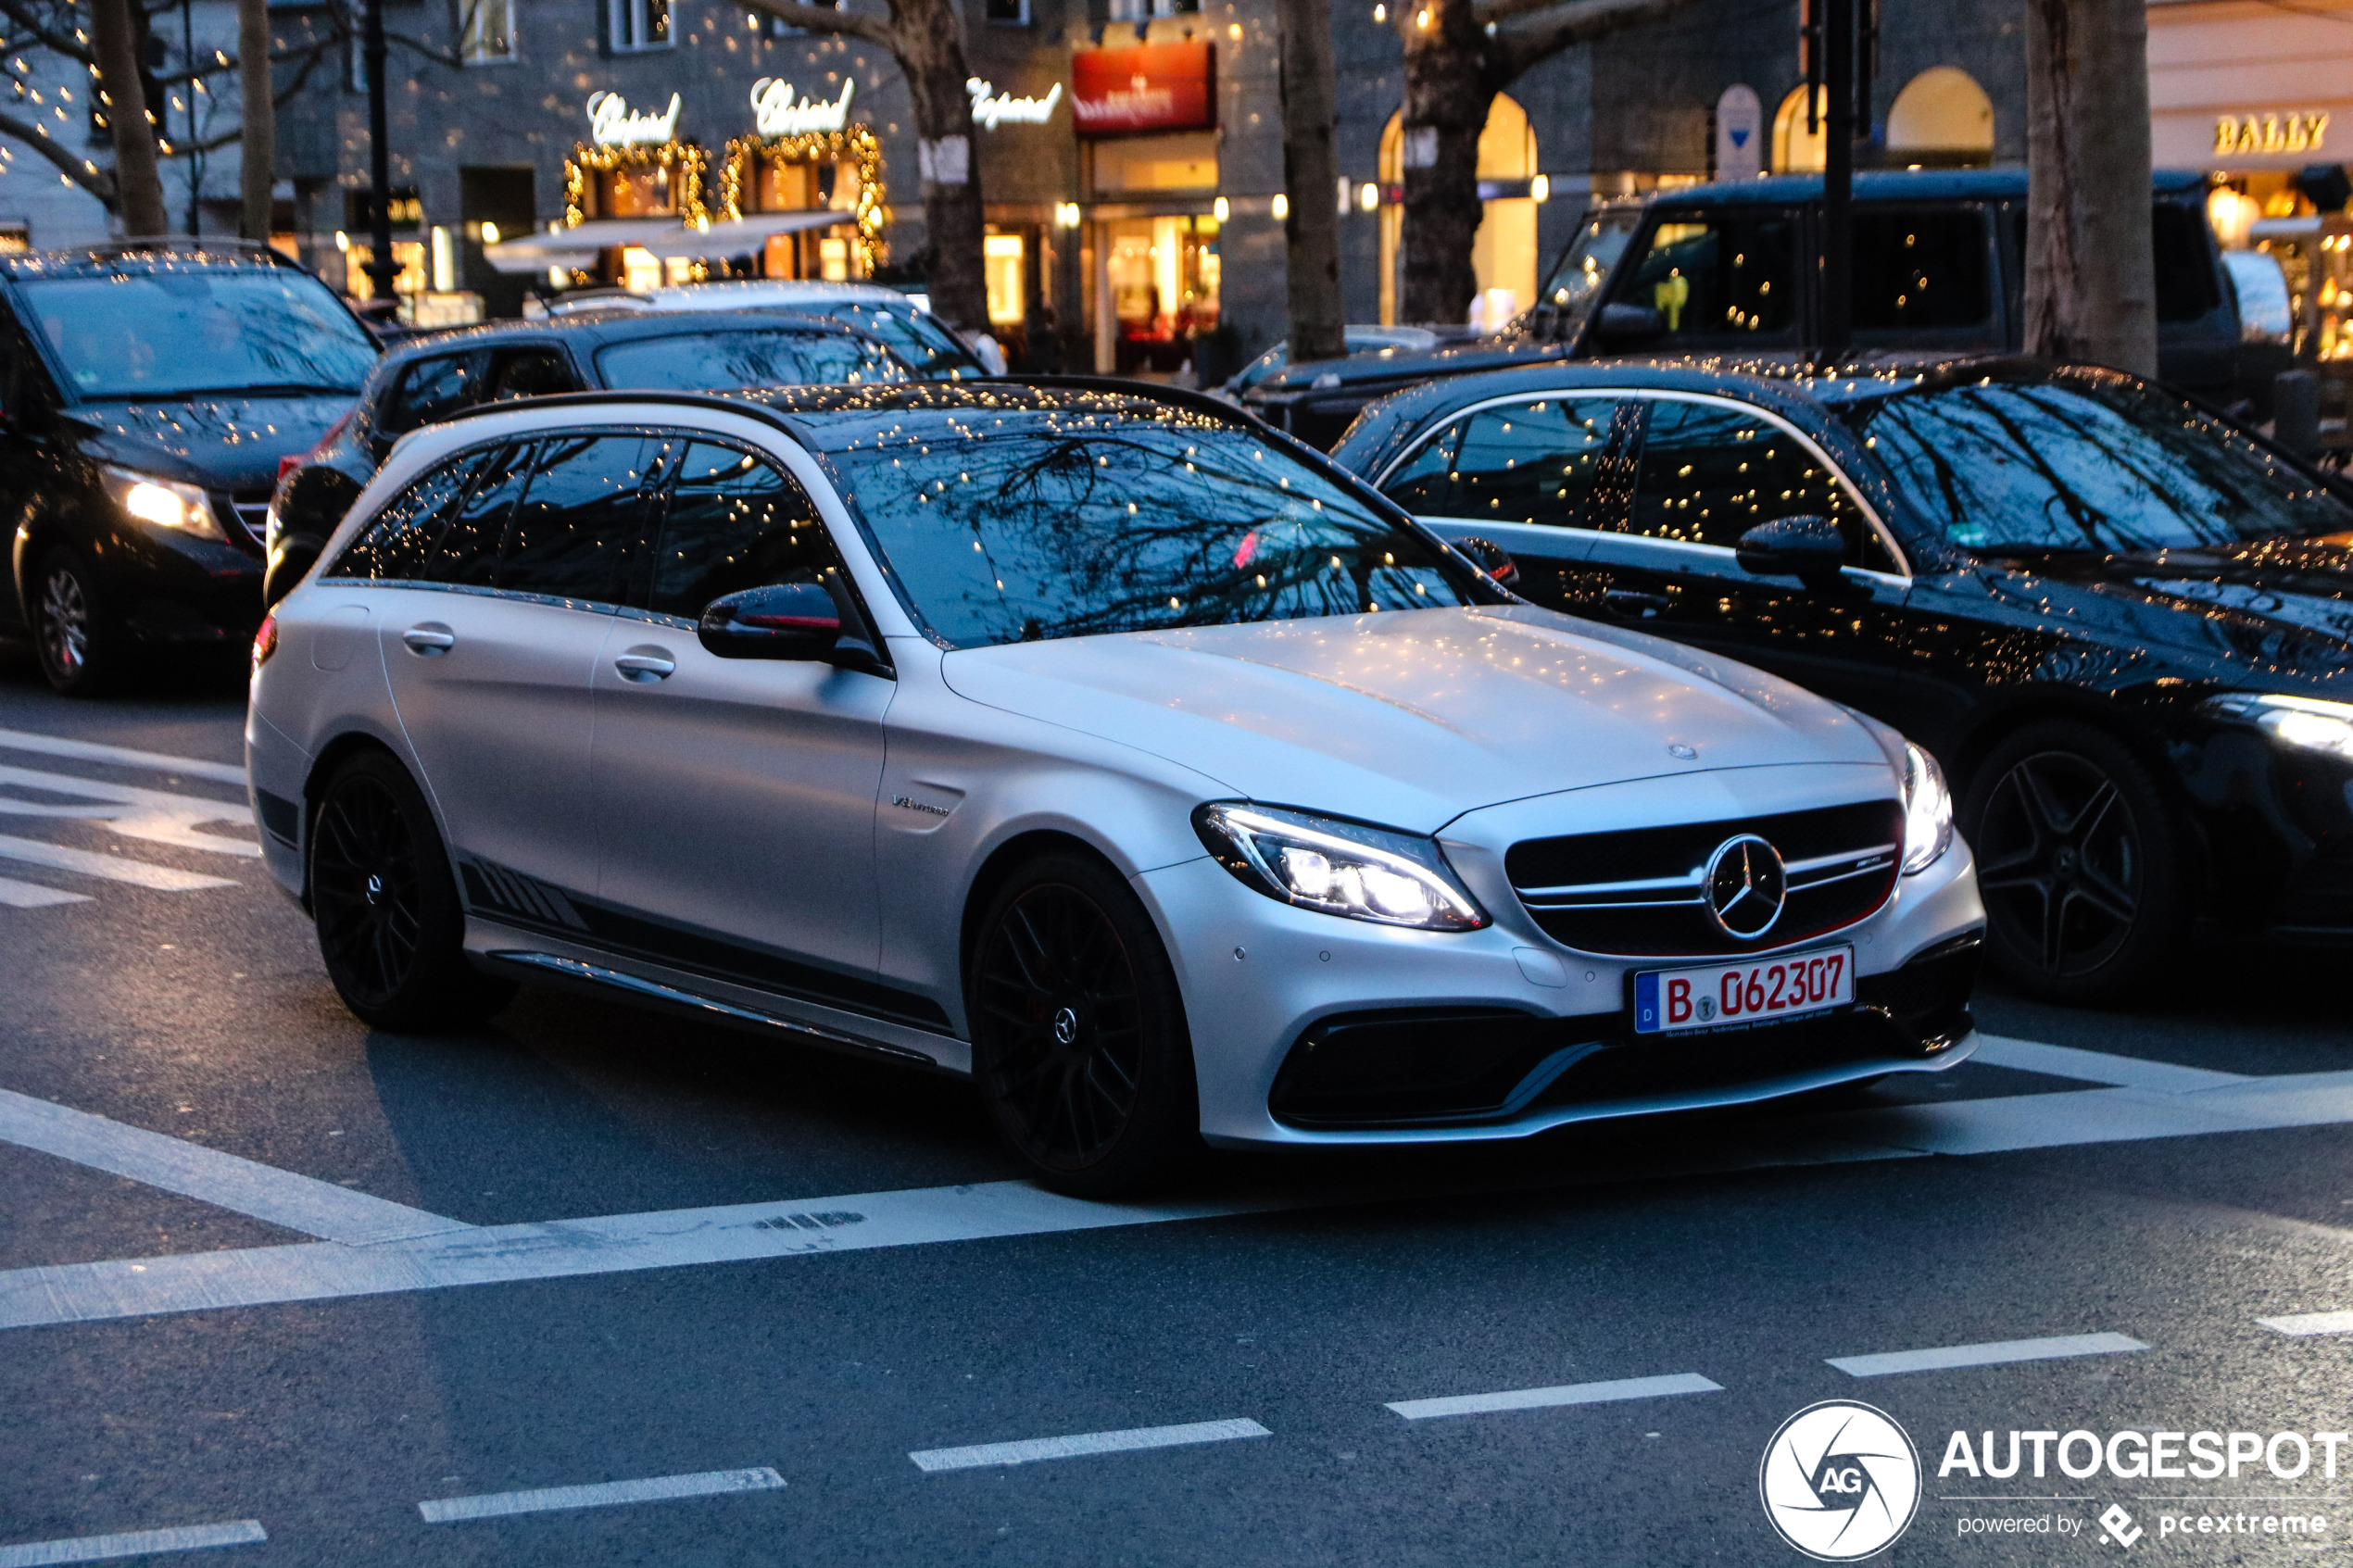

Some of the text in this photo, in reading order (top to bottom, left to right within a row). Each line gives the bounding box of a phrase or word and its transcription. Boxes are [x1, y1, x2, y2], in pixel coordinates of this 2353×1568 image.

[587, 91, 681, 148] Chopard
[750, 77, 853, 136] Chopard
[2213, 112, 2330, 157] BALLY
[1643, 1009, 1653, 1022] D
[1667, 954, 1844, 1023] B 062307
